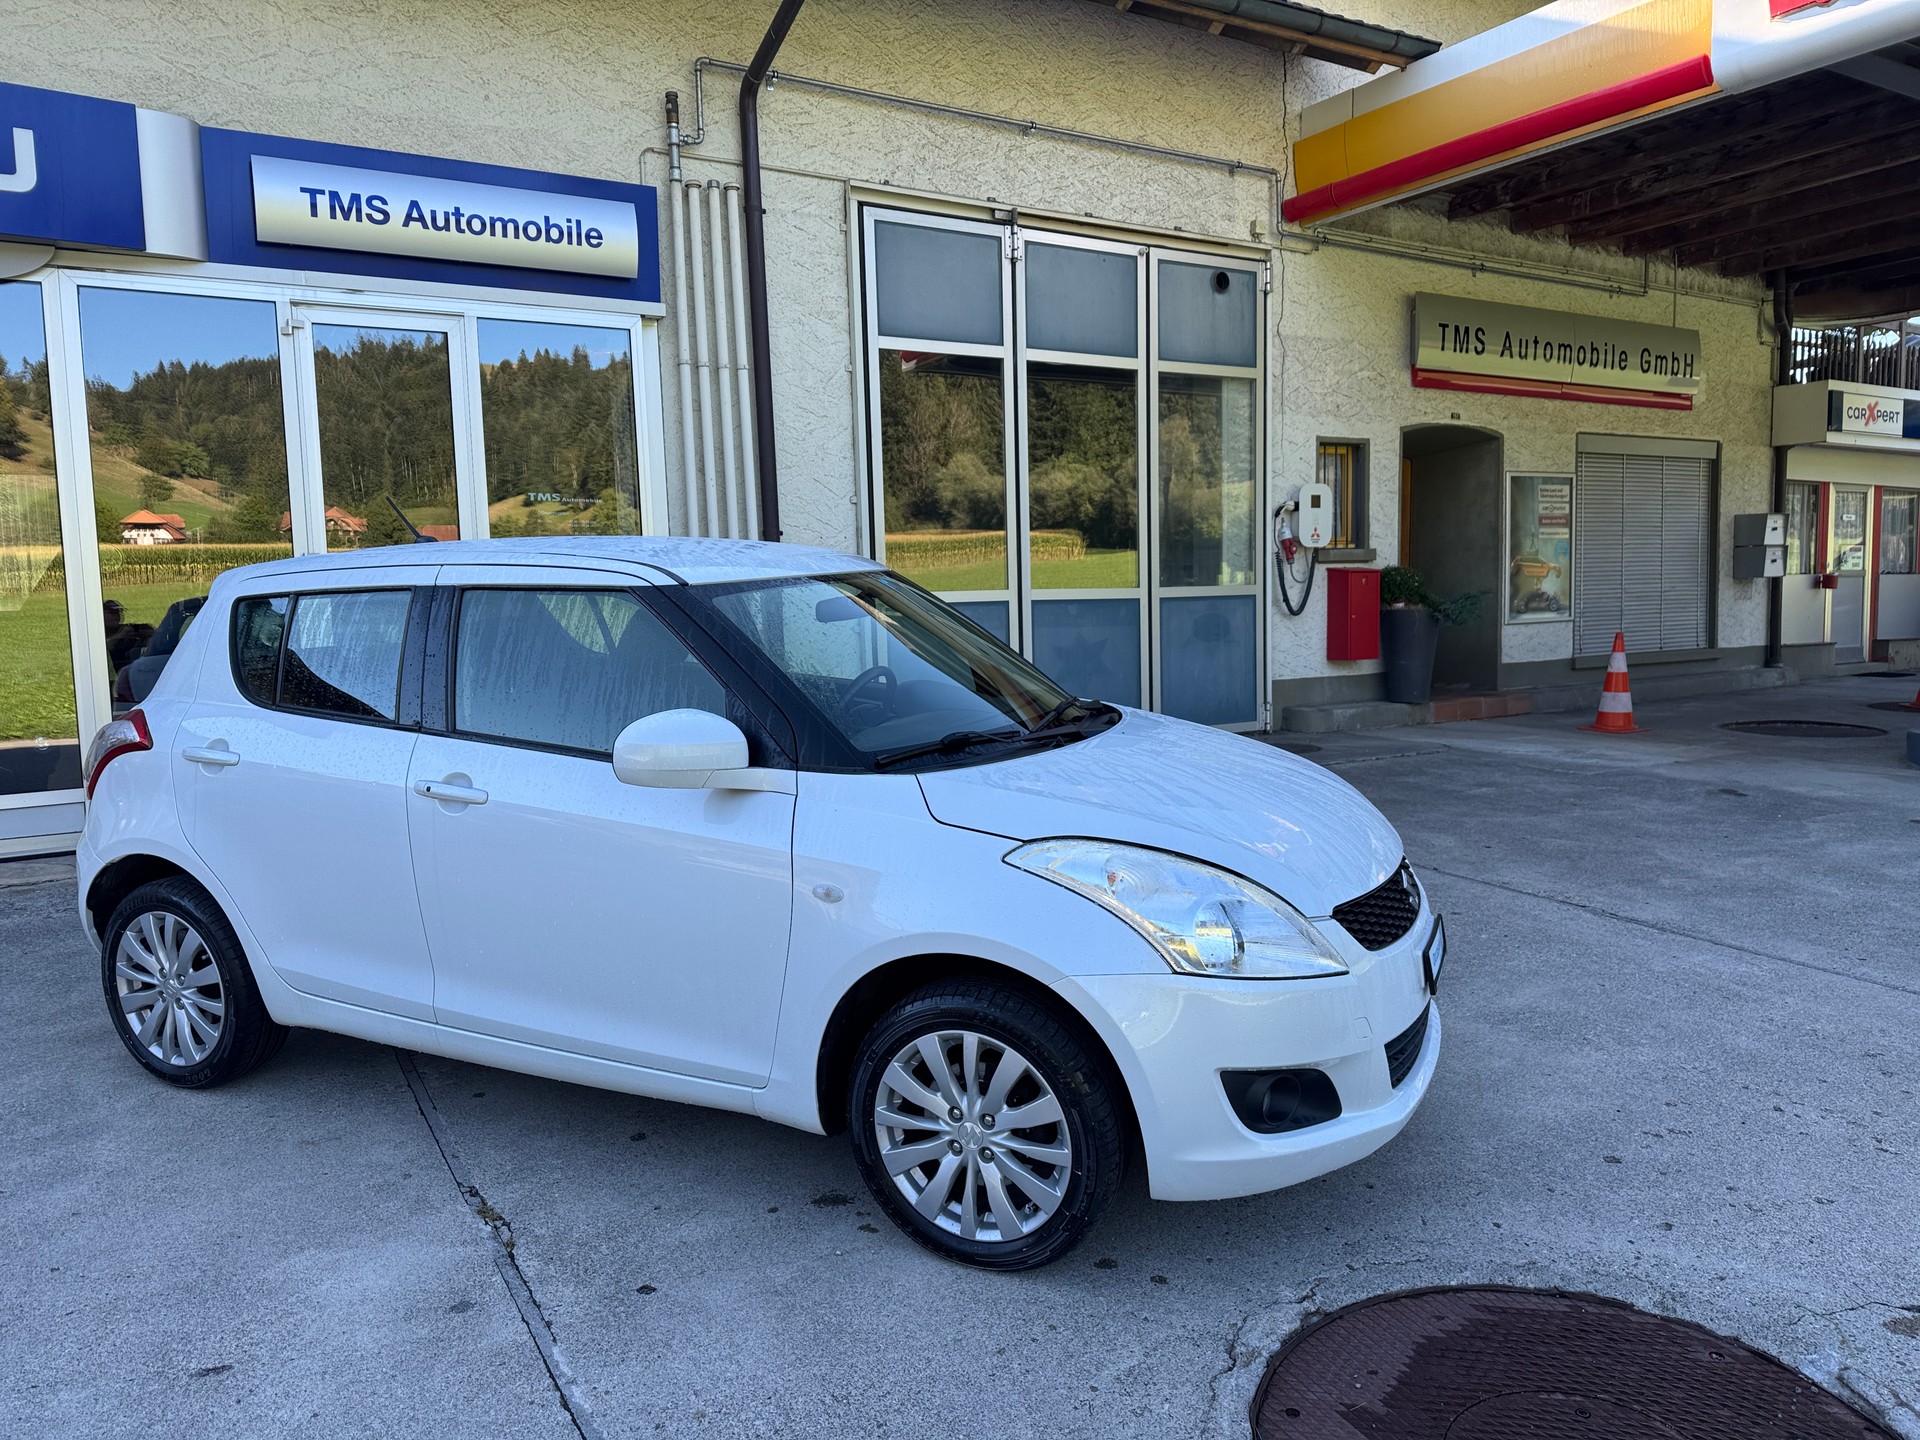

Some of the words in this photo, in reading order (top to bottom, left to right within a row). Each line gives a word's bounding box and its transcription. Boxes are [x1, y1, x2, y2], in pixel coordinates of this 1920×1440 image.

[300, 187, 390, 225] TMS
[402, 199, 603, 249] Automobile
[1438, 322, 1486, 355] TMS
[1500, 331, 1628, 371] Automobile
[1639, 347, 1694, 378] GmbH
[528, 493, 561, 502] TMS
